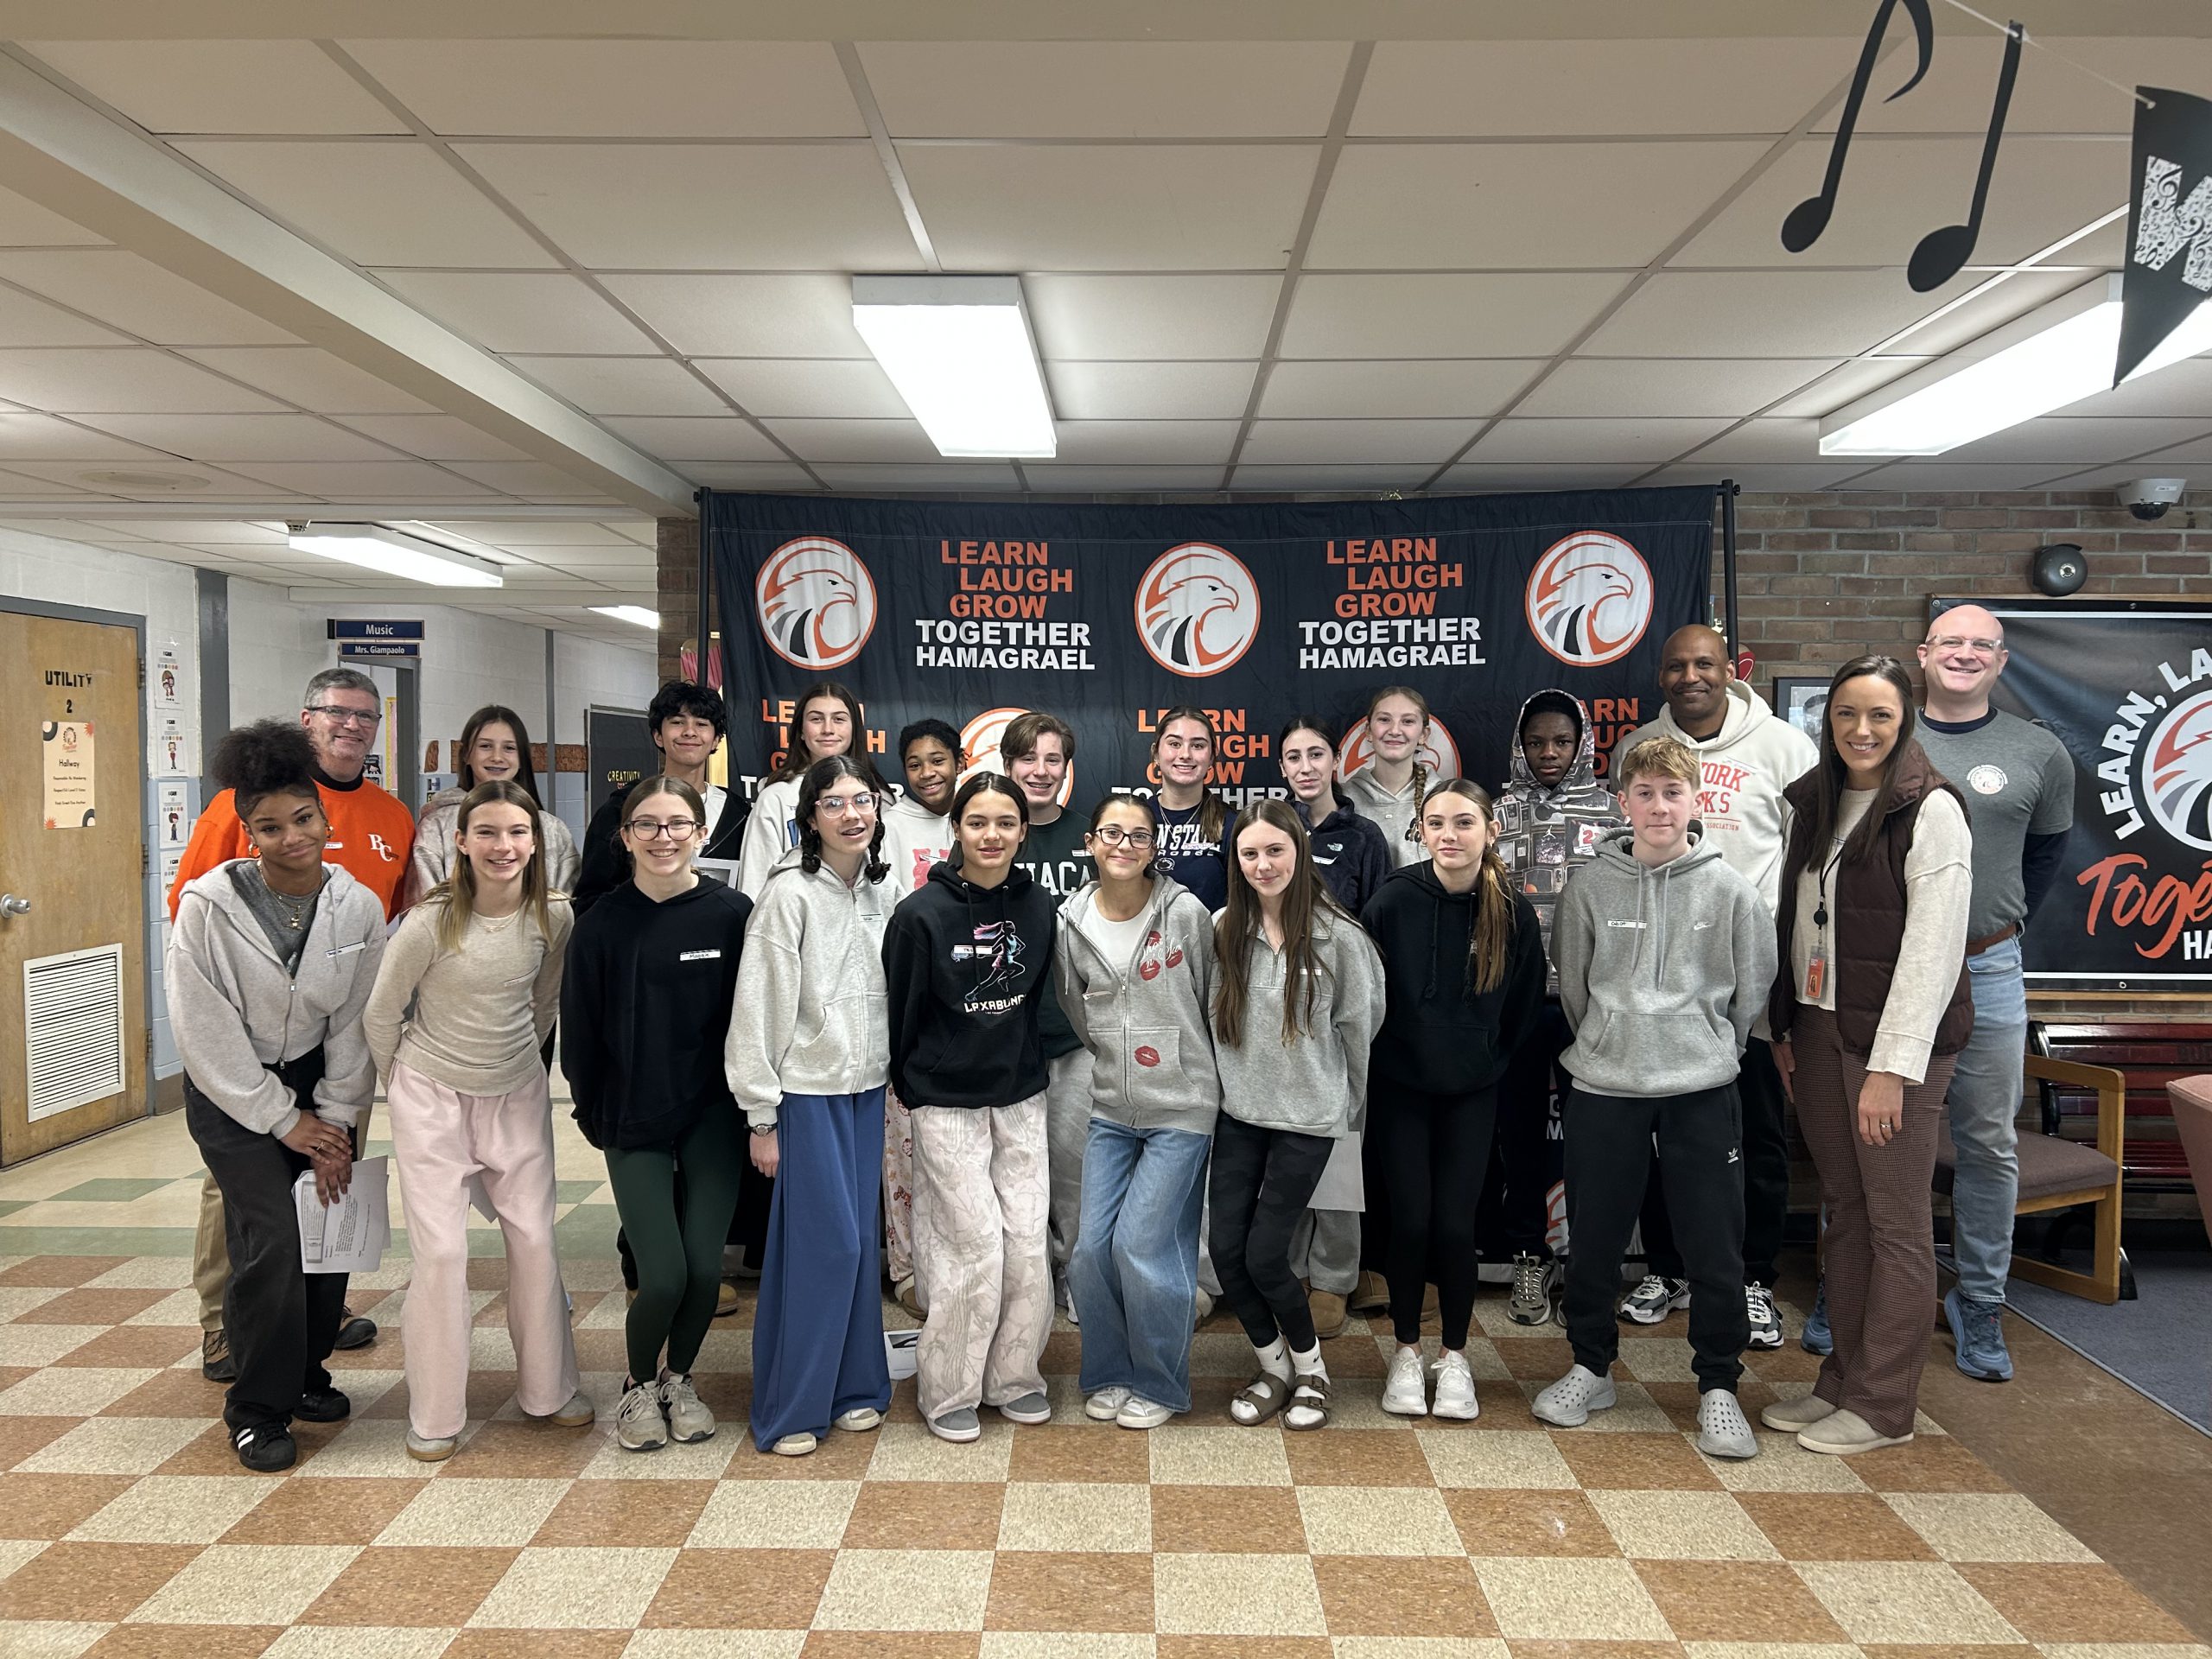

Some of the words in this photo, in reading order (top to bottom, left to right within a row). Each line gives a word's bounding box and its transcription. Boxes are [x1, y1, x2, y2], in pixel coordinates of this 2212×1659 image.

[941, 540, 1048, 565] LEARN
[1326, 537, 1437, 564] LEARN
[960, 568, 1072, 593] LAUGH
[1347, 563, 1463, 590] LAUGH
[950, 594, 1047, 619] GROW
[1335, 591, 1437, 618] GROW
[365, 624, 393, 635] Music
[915, 620, 1090, 646] TOGETHER
[1299, 617, 1481, 645] TOGETHER
[354, 645, 369, 654] Mrs.
[370, 645, 405, 655] Giampaolo
[916, 645, 1096, 671] HAMAGRAEL
[1300, 644, 1486, 670] HAMAGRAEL
[45, 670, 92, 688] UTILITY
[67, 698, 73, 714] 2
[1578, 697, 1638, 722] ARN
[1138, 709, 1245, 733] LRN
[607, 770, 641, 782] CREATIVITY
[1704, 822, 1739, 831] SSOCIATION
